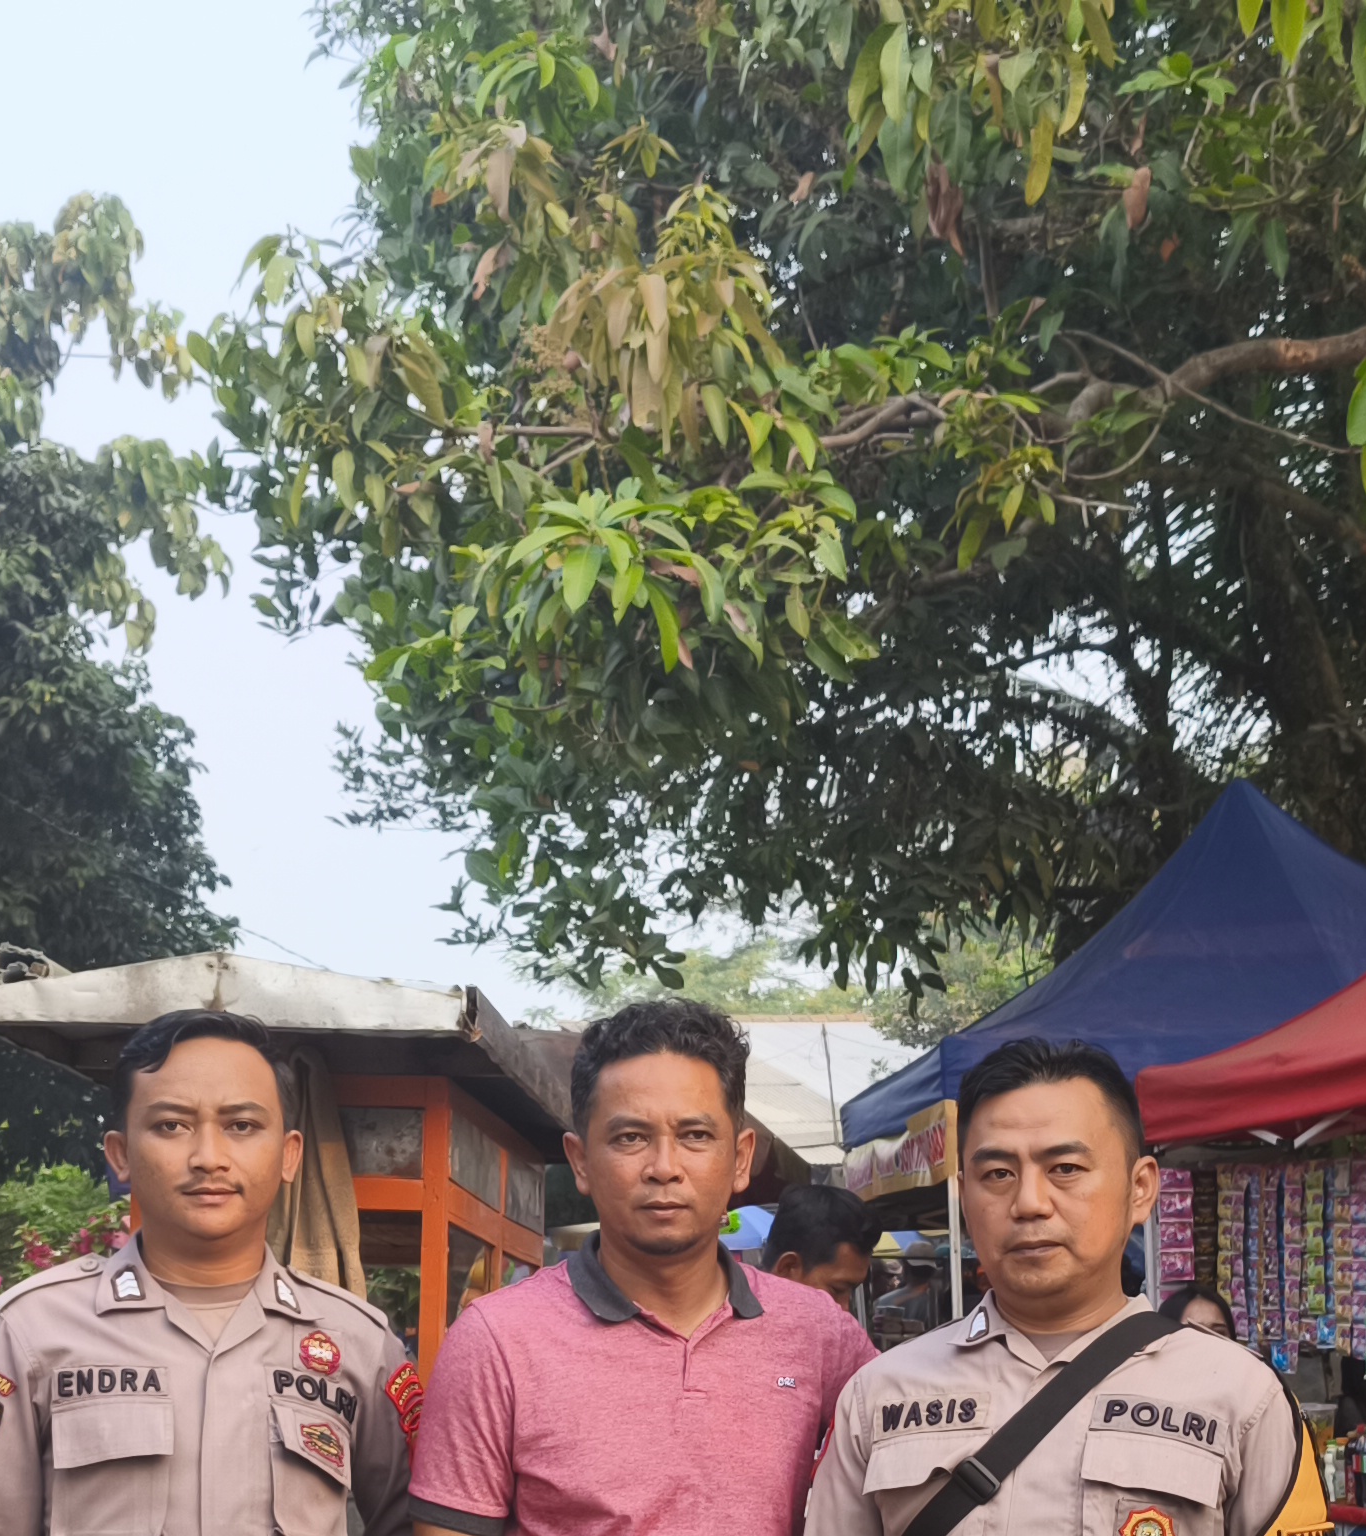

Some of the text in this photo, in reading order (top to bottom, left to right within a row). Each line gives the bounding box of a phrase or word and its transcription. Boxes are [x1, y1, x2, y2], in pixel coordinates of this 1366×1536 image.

[57, 1368, 162, 1397] ENDRA
[272, 1369, 357, 1424] POLRI
[882, 1397, 978, 1433] WASIS
[1103, 1399, 1217, 1446] POLRI
